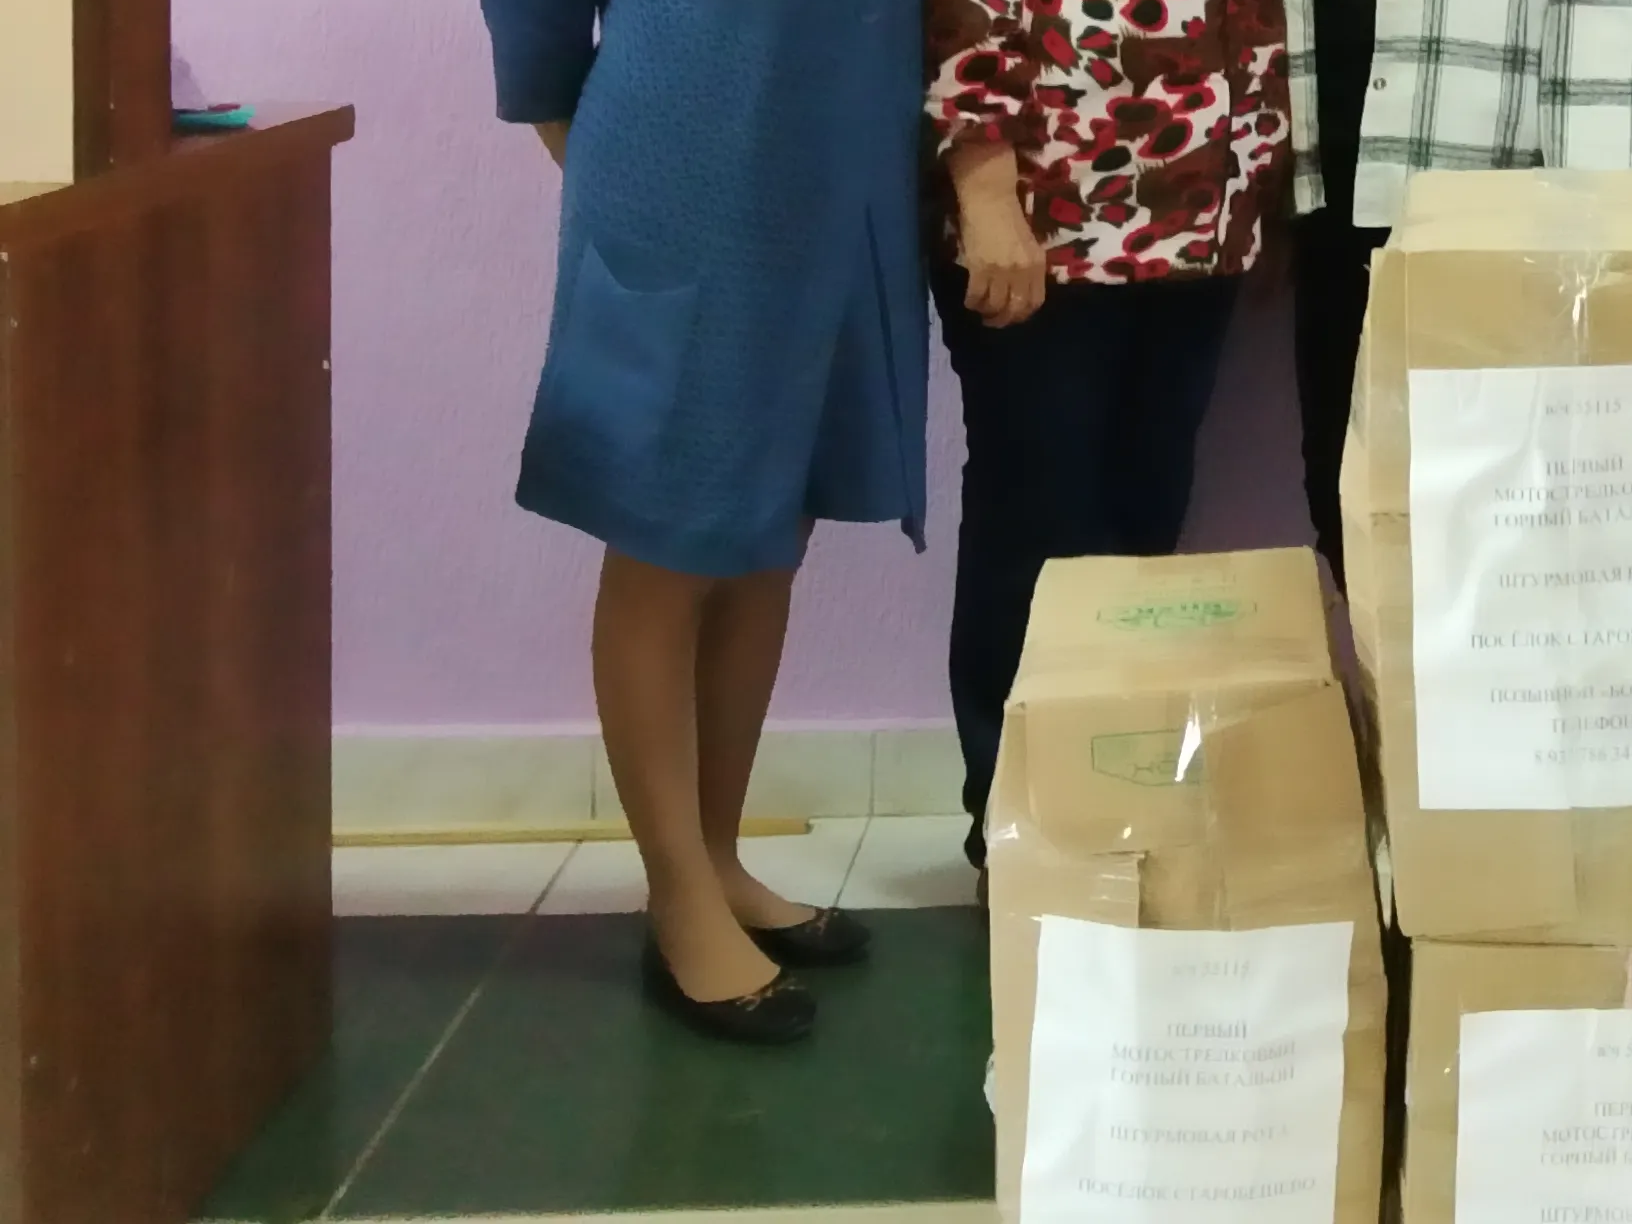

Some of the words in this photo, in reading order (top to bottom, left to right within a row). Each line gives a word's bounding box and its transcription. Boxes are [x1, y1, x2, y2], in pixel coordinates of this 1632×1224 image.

[1546, 455, 1623, 477] ПЕРВЫЙ
[1494, 507, 1571, 529] ГОРНЫЙ
[1498, 566, 1622, 589] ШТУРМОВАЯ
[1167, 1019, 1247, 1039] ПЕРВЫЙ
[1111, 1040, 1296, 1063] МОТОСТРЕЛКОВЫЙ
[1110, 1065, 1190, 1086] ГОРНЫЙ
[1196, 1065, 1295, 1088] БАТАЛЬОН
[1110, 1124, 1235, 1144] ШТУРМОВАЯ
[1242, 1124, 1289, 1143] РОТА
[1540, 1147, 1617, 1166] ГОРНЫЙ
[1173, 1176, 1315, 1202] СТАРОБЕШЕВО
